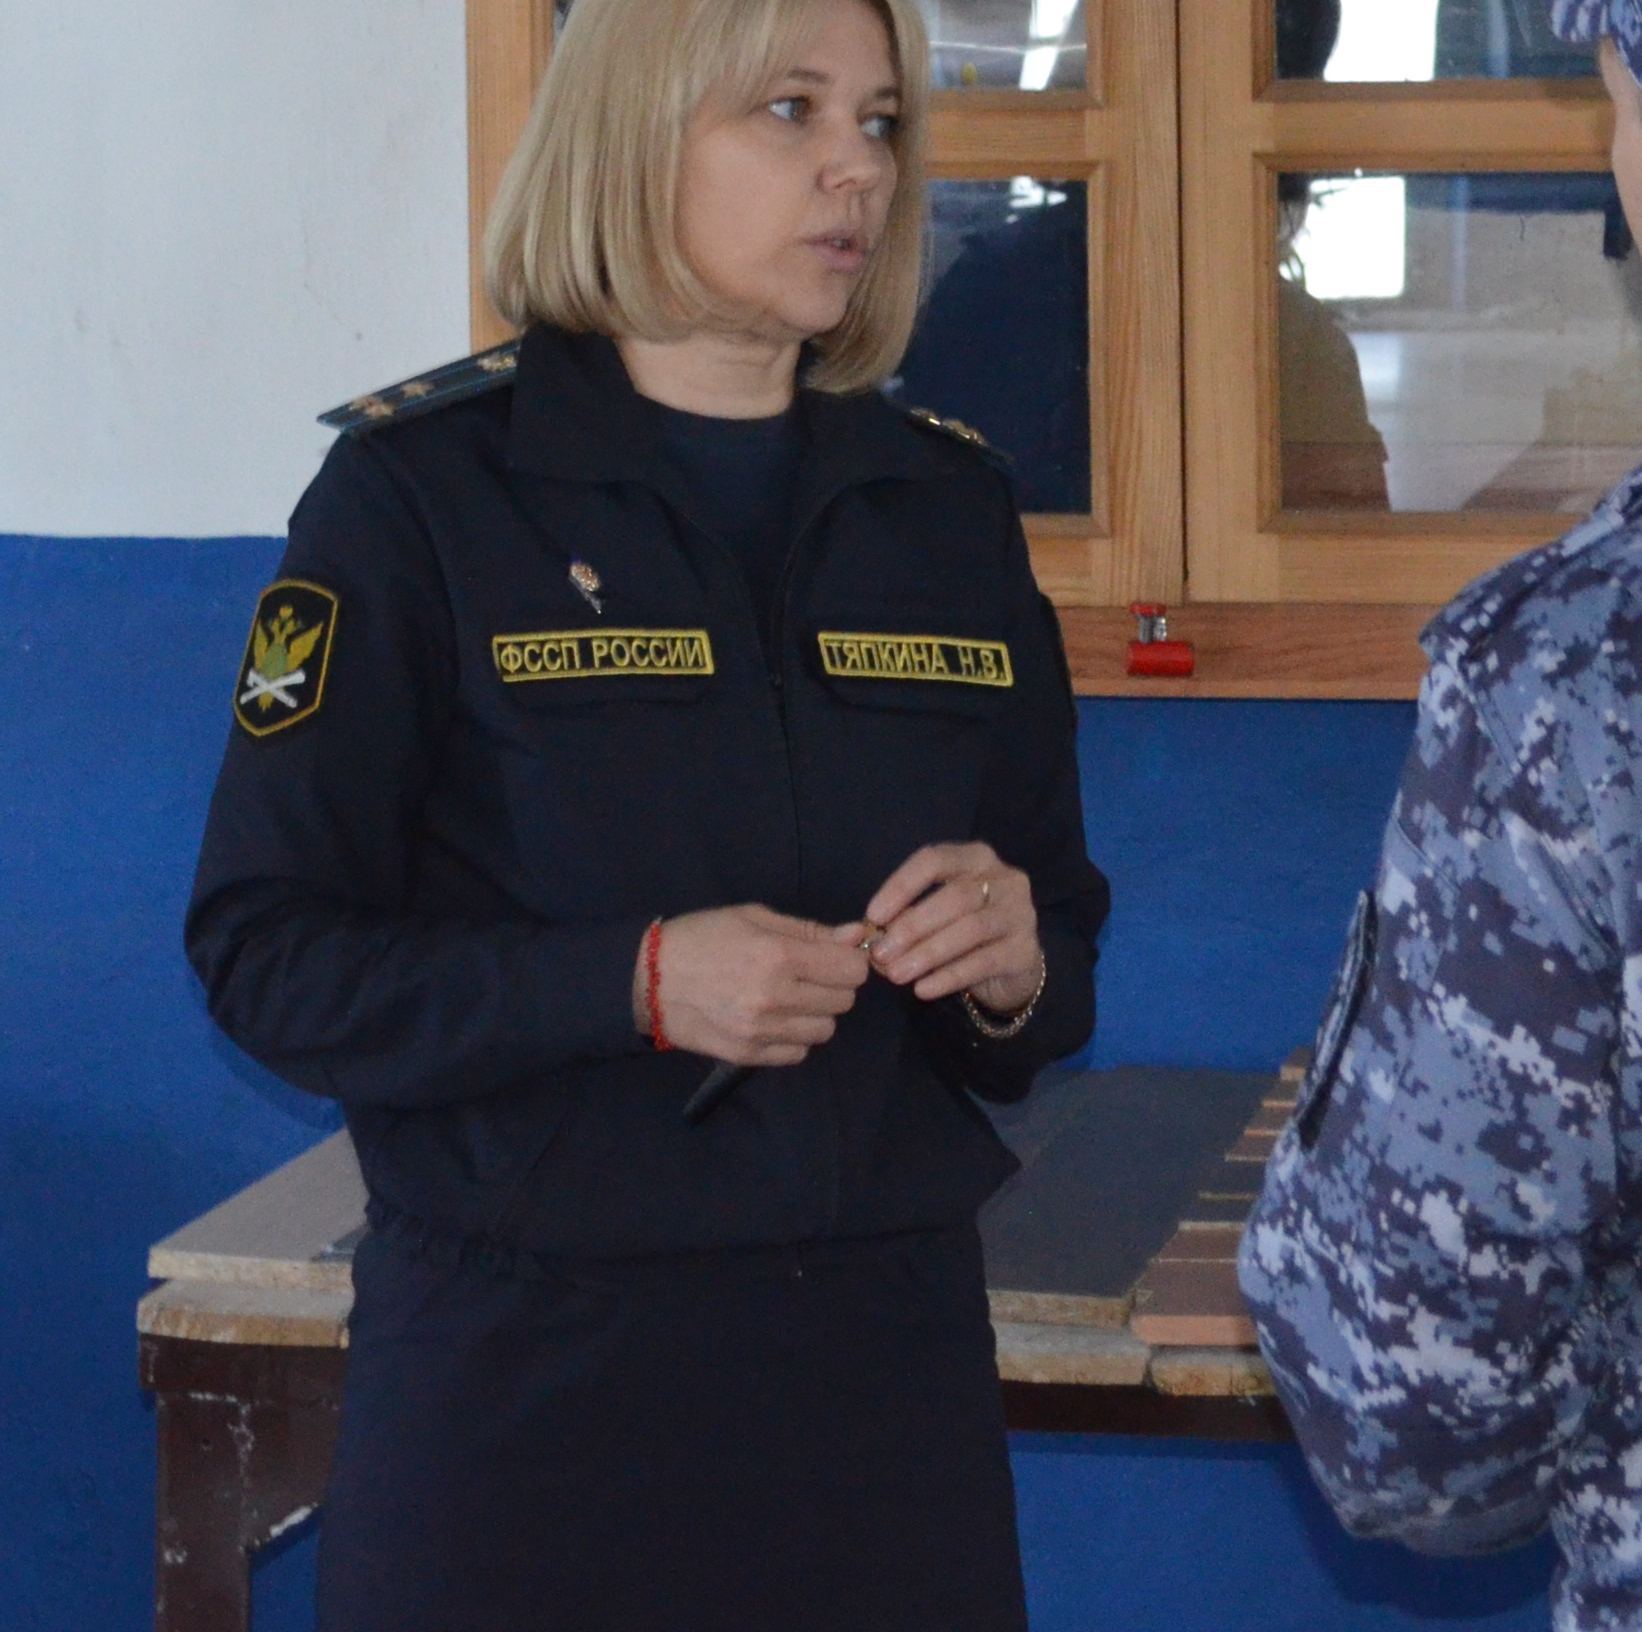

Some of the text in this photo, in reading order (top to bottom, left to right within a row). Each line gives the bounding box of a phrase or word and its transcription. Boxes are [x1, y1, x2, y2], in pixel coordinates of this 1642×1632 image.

[501, 637, 704, 672] ФССП РОССИИ
[829, 641, 1005, 680] ТЯПКИНА Н.В.
